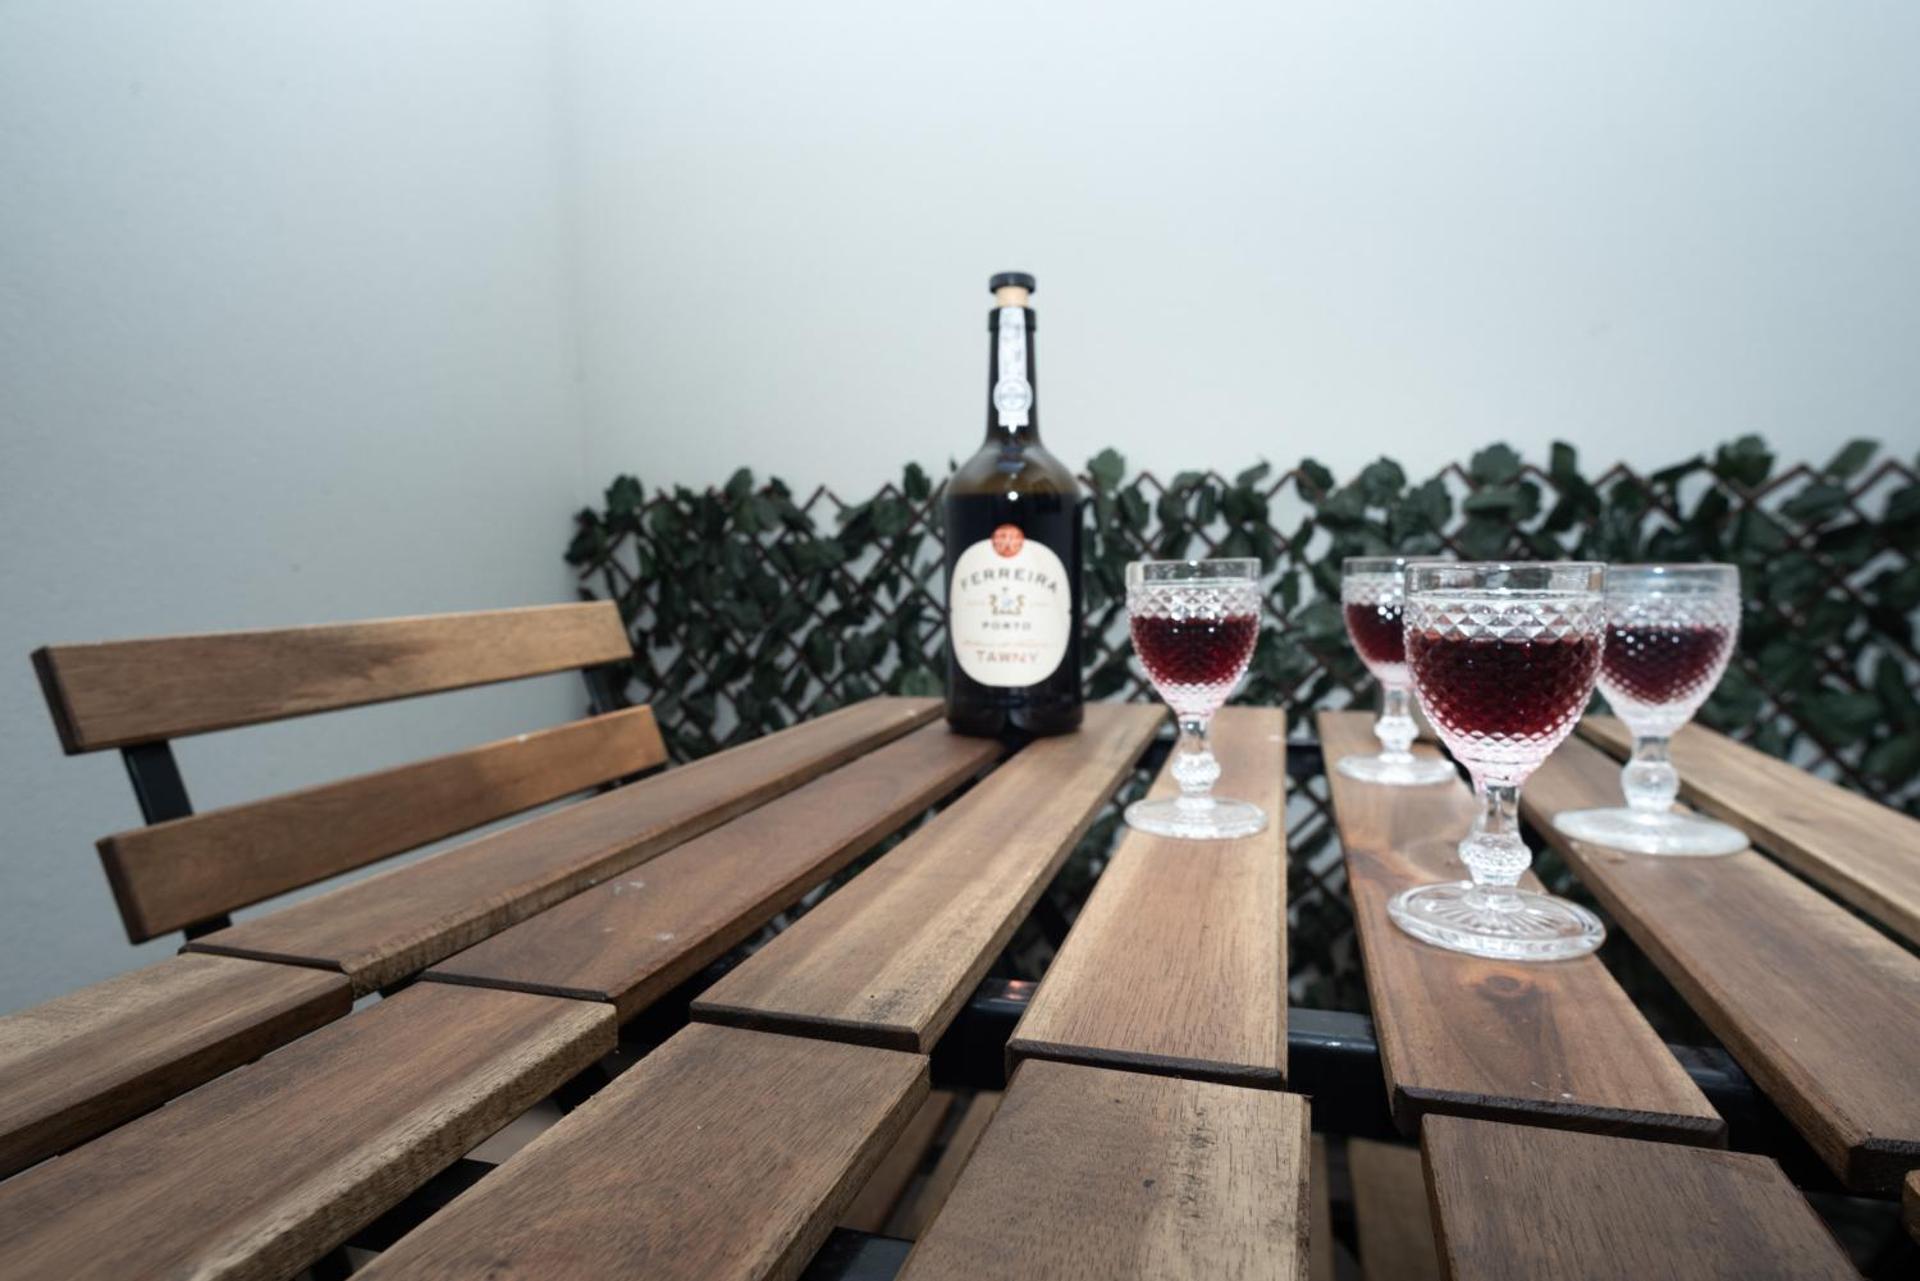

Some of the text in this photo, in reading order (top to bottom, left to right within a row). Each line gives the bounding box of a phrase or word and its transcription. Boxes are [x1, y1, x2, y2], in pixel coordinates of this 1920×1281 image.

[960, 567, 1057, 593] FERREIRA
[982, 621, 1031, 630] PORTO
[976, 650, 1039, 663] TAWNY
